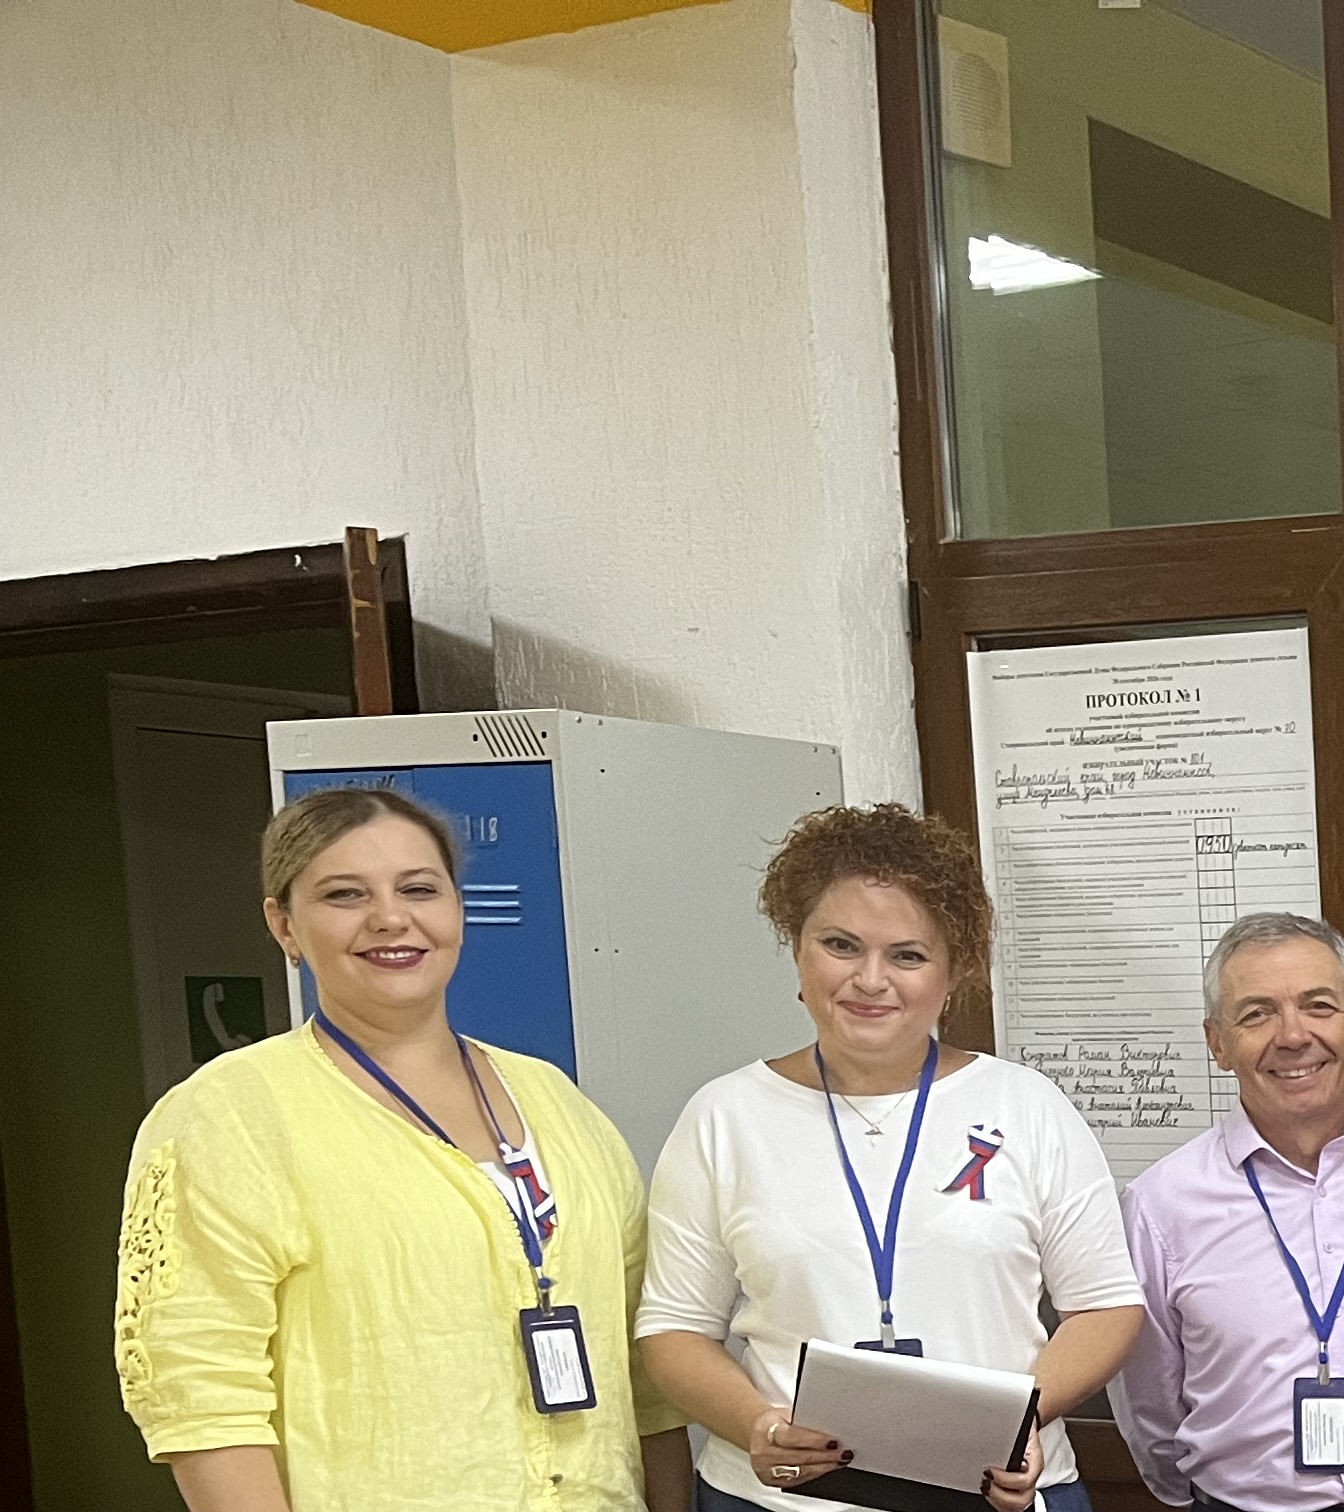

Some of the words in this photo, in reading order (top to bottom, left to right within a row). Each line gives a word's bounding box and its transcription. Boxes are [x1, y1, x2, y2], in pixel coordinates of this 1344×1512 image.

[1086, 690, 1171, 709] ПРОТОКОЛ
[1175, 689, 1190, 703] №
[1195, 688, 1200, 702] 1
